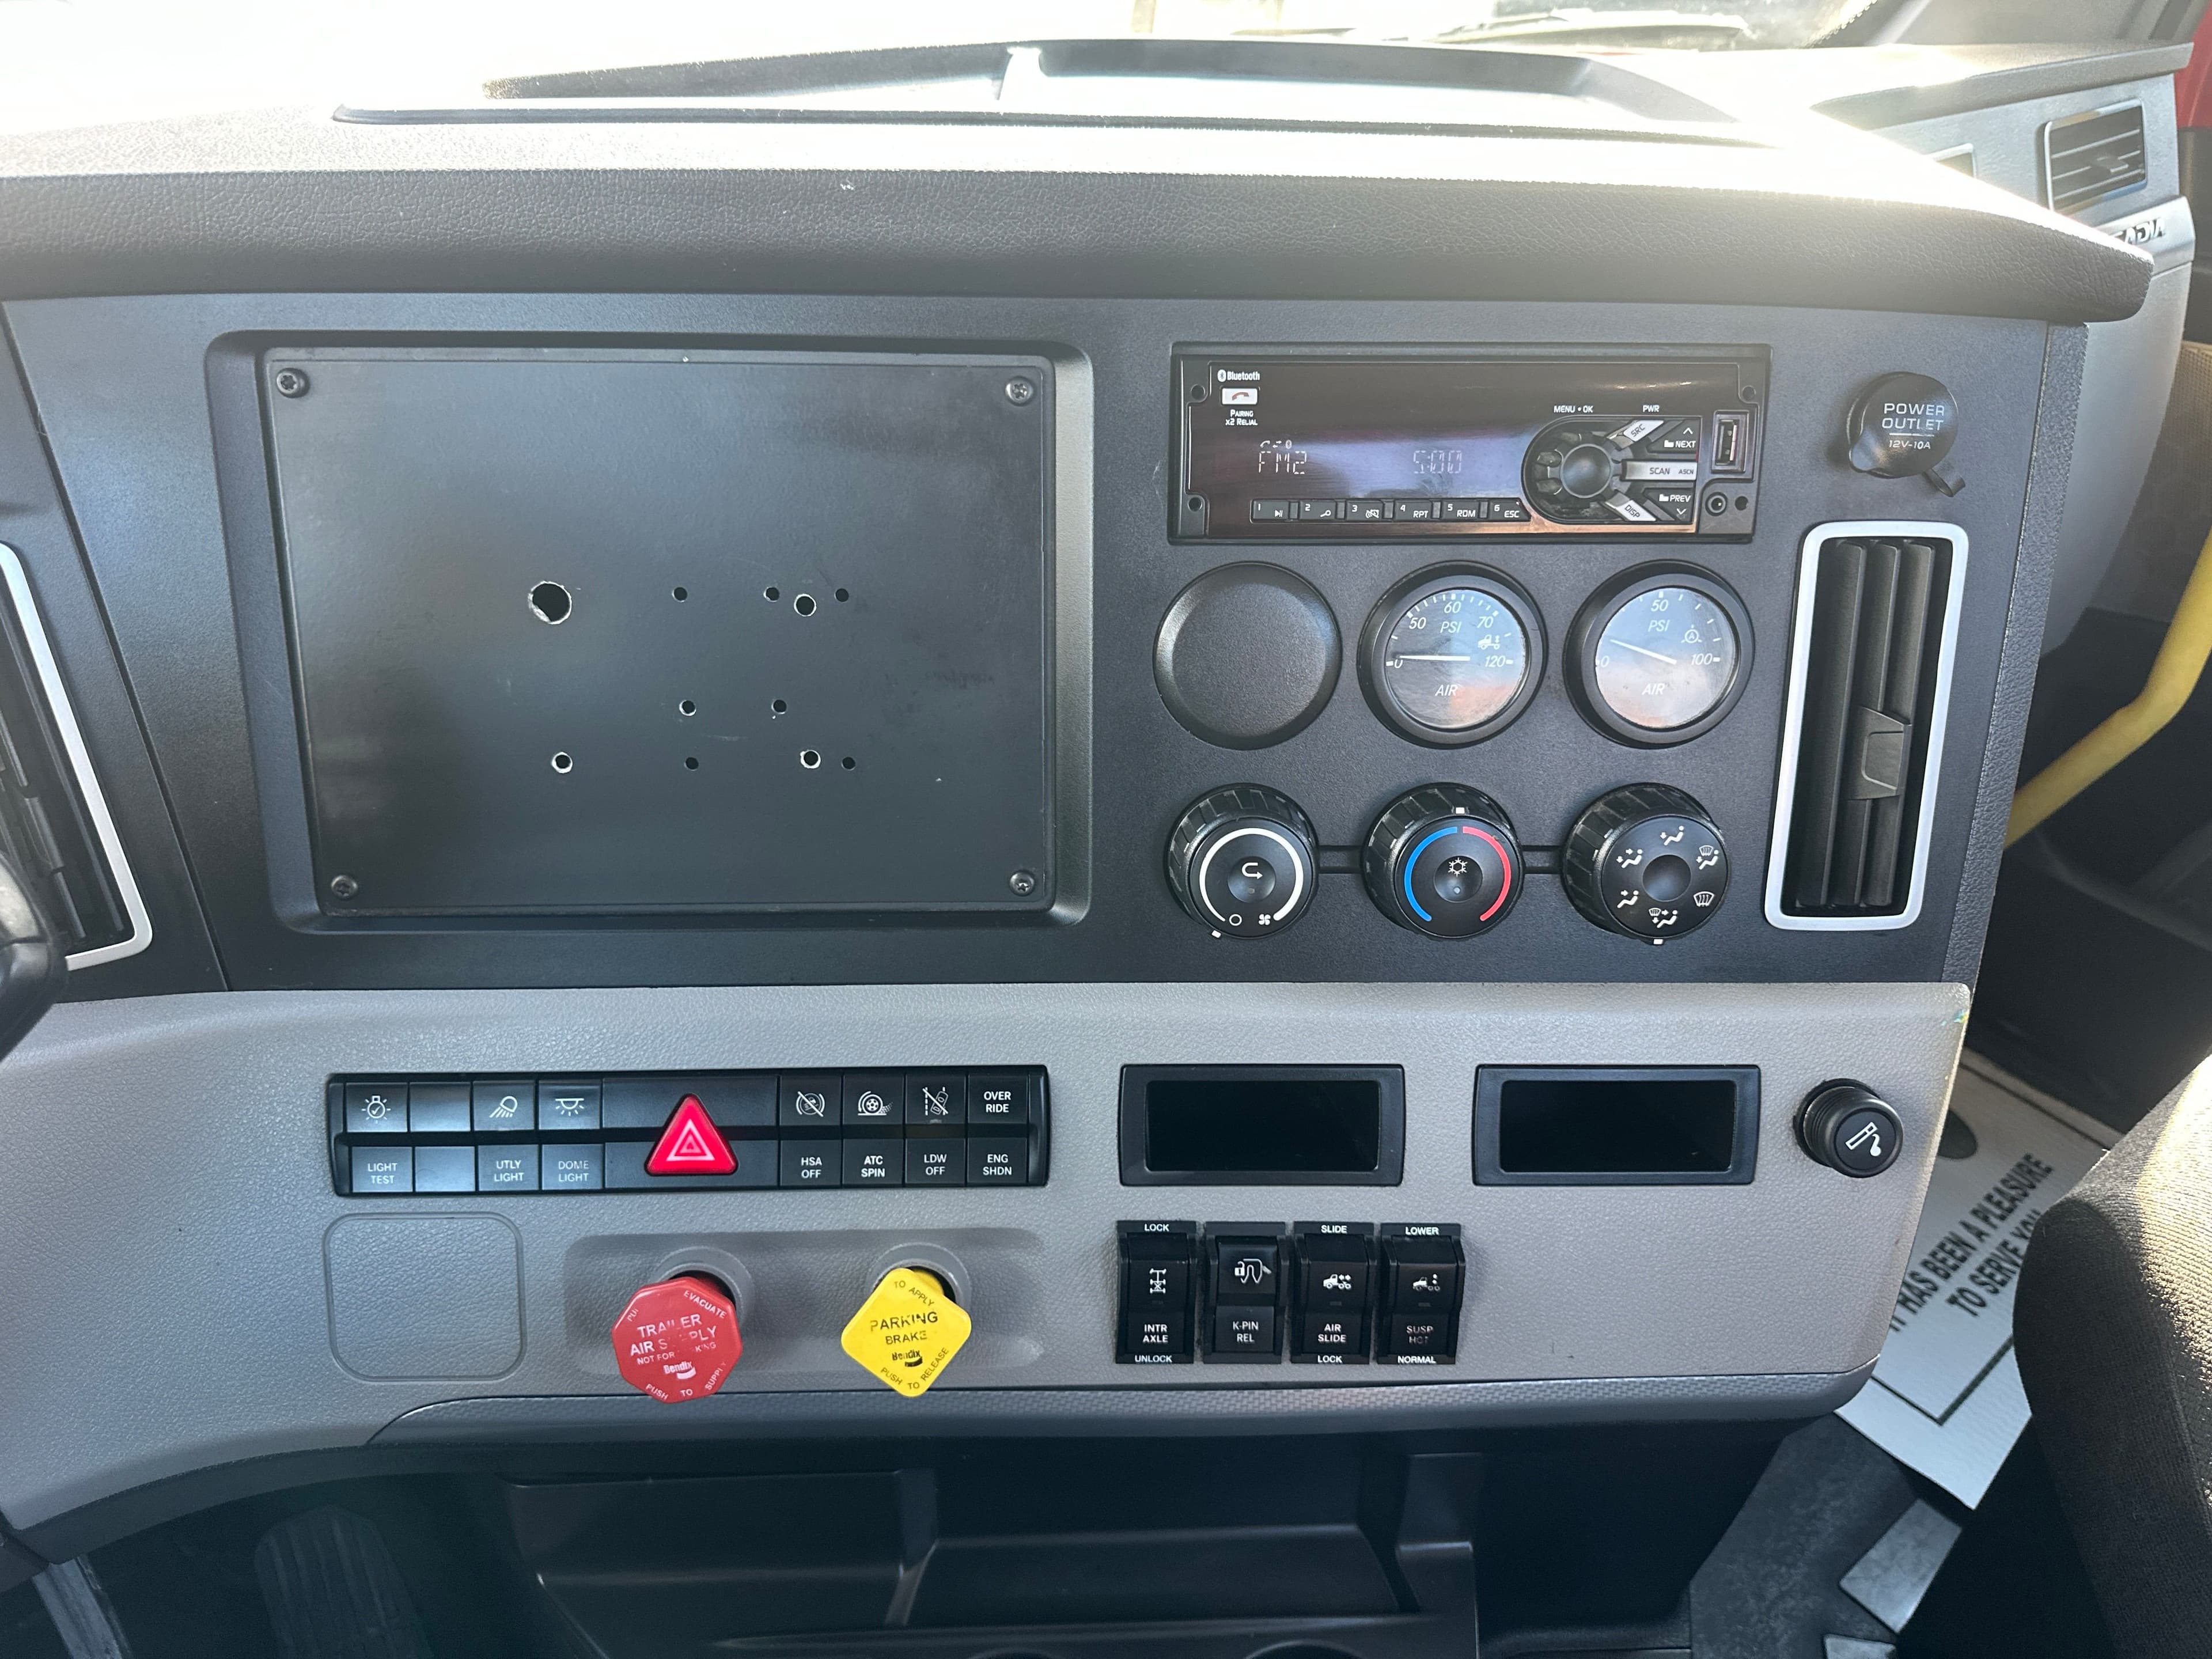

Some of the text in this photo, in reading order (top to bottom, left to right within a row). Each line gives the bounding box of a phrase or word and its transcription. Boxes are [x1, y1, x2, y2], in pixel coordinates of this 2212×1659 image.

[1227, 371, 1260, 380] Bluetooth
[1884, 403, 1945, 416] POWER
[1631, 423, 1646, 437] SRC
[1881, 418, 1944, 431] OUTLET
[1889, 440, 1931, 449] 12V-10A
[1259, 450, 1307, 474] FM2
[1457, 510, 1476, 518] RDM
[1624, 505, 1641, 518] DISP
[1444, 601, 1461, 613] 60
[1650, 599, 1669, 612] 50
[1409, 617, 1426, 630] 50
[1477, 616, 1494, 628] 70
[1648, 620, 1670, 632] PSI
[1440, 622, 1461, 634] PSI
[1484, 656, 1506, 667] 120
[1600, 656, 1609, 667] 0
[1691, 653, 1713, 665] 100
[1435, 684, 1459, 696] AIR
[1642, 683, 1665, 695] AIR
[983, 1091, 1012, 1101] OVER
[986, 1103, 1009, 1113] RIDE
[496, 1160, 522, 1169] UTLY
[801, 1157, 822, 1166] HSA
[864, 1156, 883, 1165] ATC
[924, 1154, 947, 1164] LDW
[987, 1154, 1008, 1164] ENG
[368, 1162, 397, 1172] LIGHT
[558, 1161, 589, 1170] DOME
[925, 1166, 945, 1176] OFF
[983, 1166, 1012, 1176] SHDN
[494, 1172, 524, 1183] LIGHT
[558, 1173, 589, 1183] LIGHT
[801, 1169, 821, 1179] OFF
[861, 1168, 885, 1178] SPIN
[371, 1175, 395, 1184] TEST
[1968, 1152, 2054, 1230] PLEASURE
[1145, 1224, 1169, 1232] LOCK
[1321, 1225, 1347, 1233] SLIDE
[1405, 1226, 1439, 1235] LOWER
[1959, 1219, 1991, 1243] A
[1920, 1230, 1978, 1280] BEEN
[1945, 1287, 1987, 1317] TO
[1968, 1239, 2022, 1294] SERVE
[894, 1281, 934, 1306] TO APPLY
[1897, 1270, 1940, 1315] HAS
[684, 1290, 726, 1319] EVACUATE
[870, 1312, 938, 1332] PARKING
[1233, 1321, 1259, 1331] K-PIN
[1144, 1324, 1167, 1332] INTR
[1324, 1324, 1342, 1332] AIR
[1406, 1325, 1433, 1334] SUSP
[885, 1330, 927, 1345] BRAKE
[1143, 1335, 1168, 1343] AXLE
[1237, 1334, 1255, 1342] REL
[1318, 1334, 1346, 1343] SLIDE
[630, 1340, 655, 1357] AIR
[637, 1351, 675, 1365] NOT FOR
[1317, 1355, 1342, 1363] LOCK
[1397, 1355, 1436, 1363] NORMAL
[664, 1361, 693, 1374] Bendix
[881, 1347, 949, 1390] PUSH TO RELEASE
[646, 1383, 669, 1400] PUSH
[680, 1389, 693, 1397] TO
